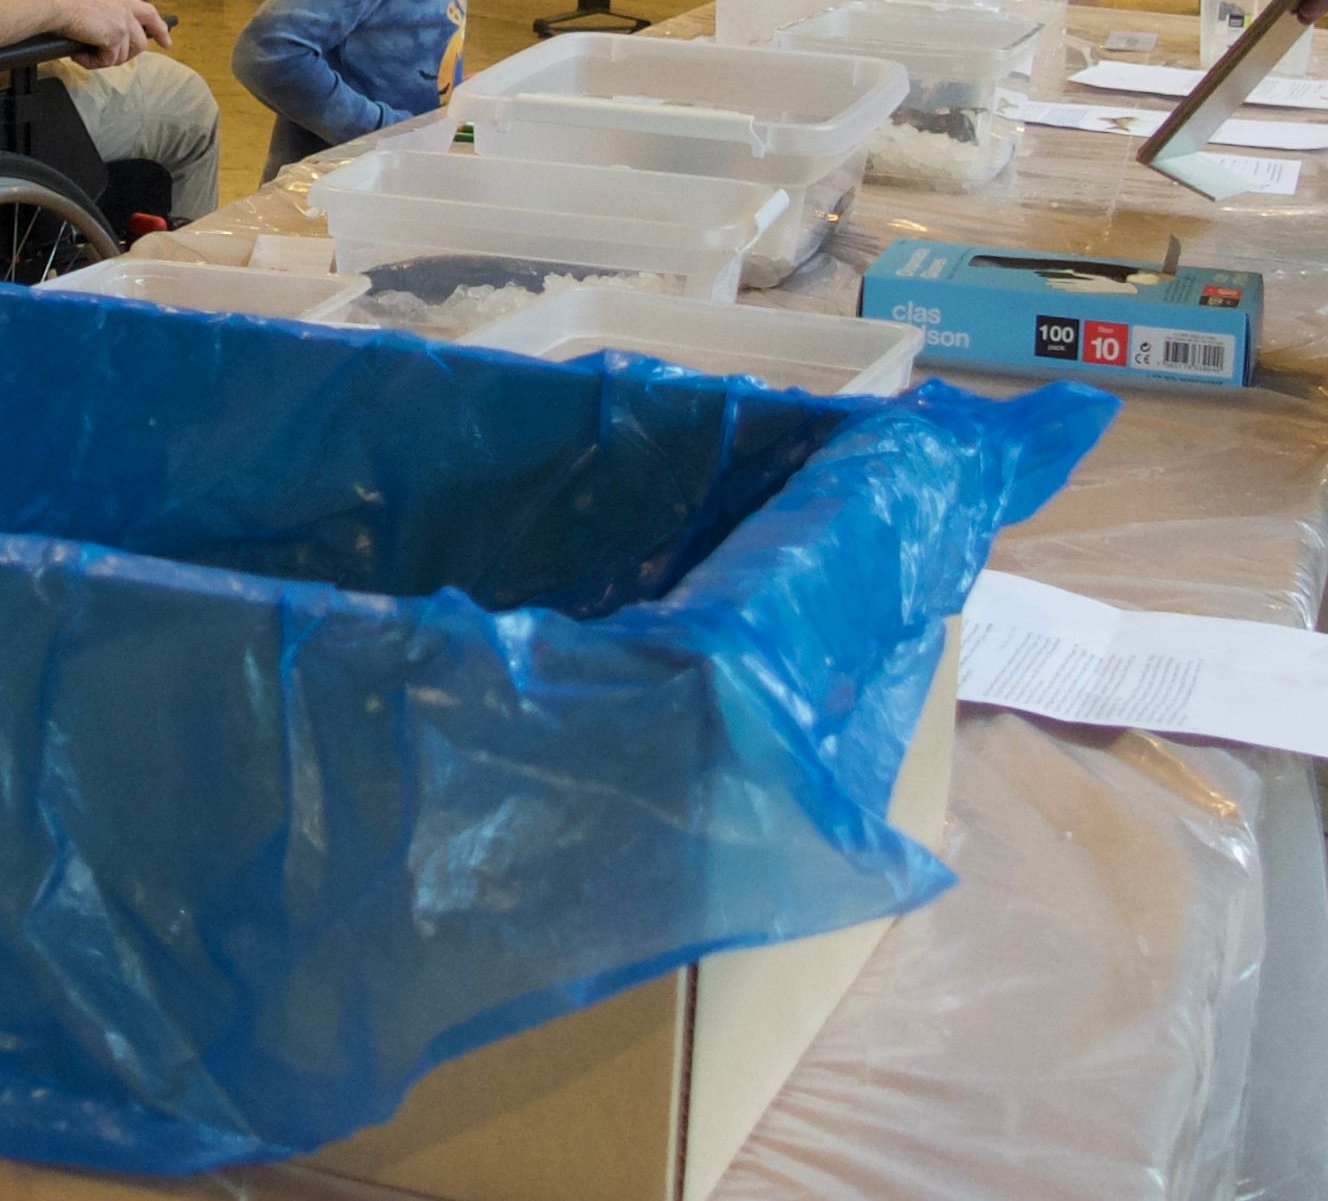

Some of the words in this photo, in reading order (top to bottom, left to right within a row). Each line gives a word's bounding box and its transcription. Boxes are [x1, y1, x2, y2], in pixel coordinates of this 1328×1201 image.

[892, 301, 941, 325] clas
[1039, 324, 1075, 344] 100
[1091, 336, 1119, 361] 10
